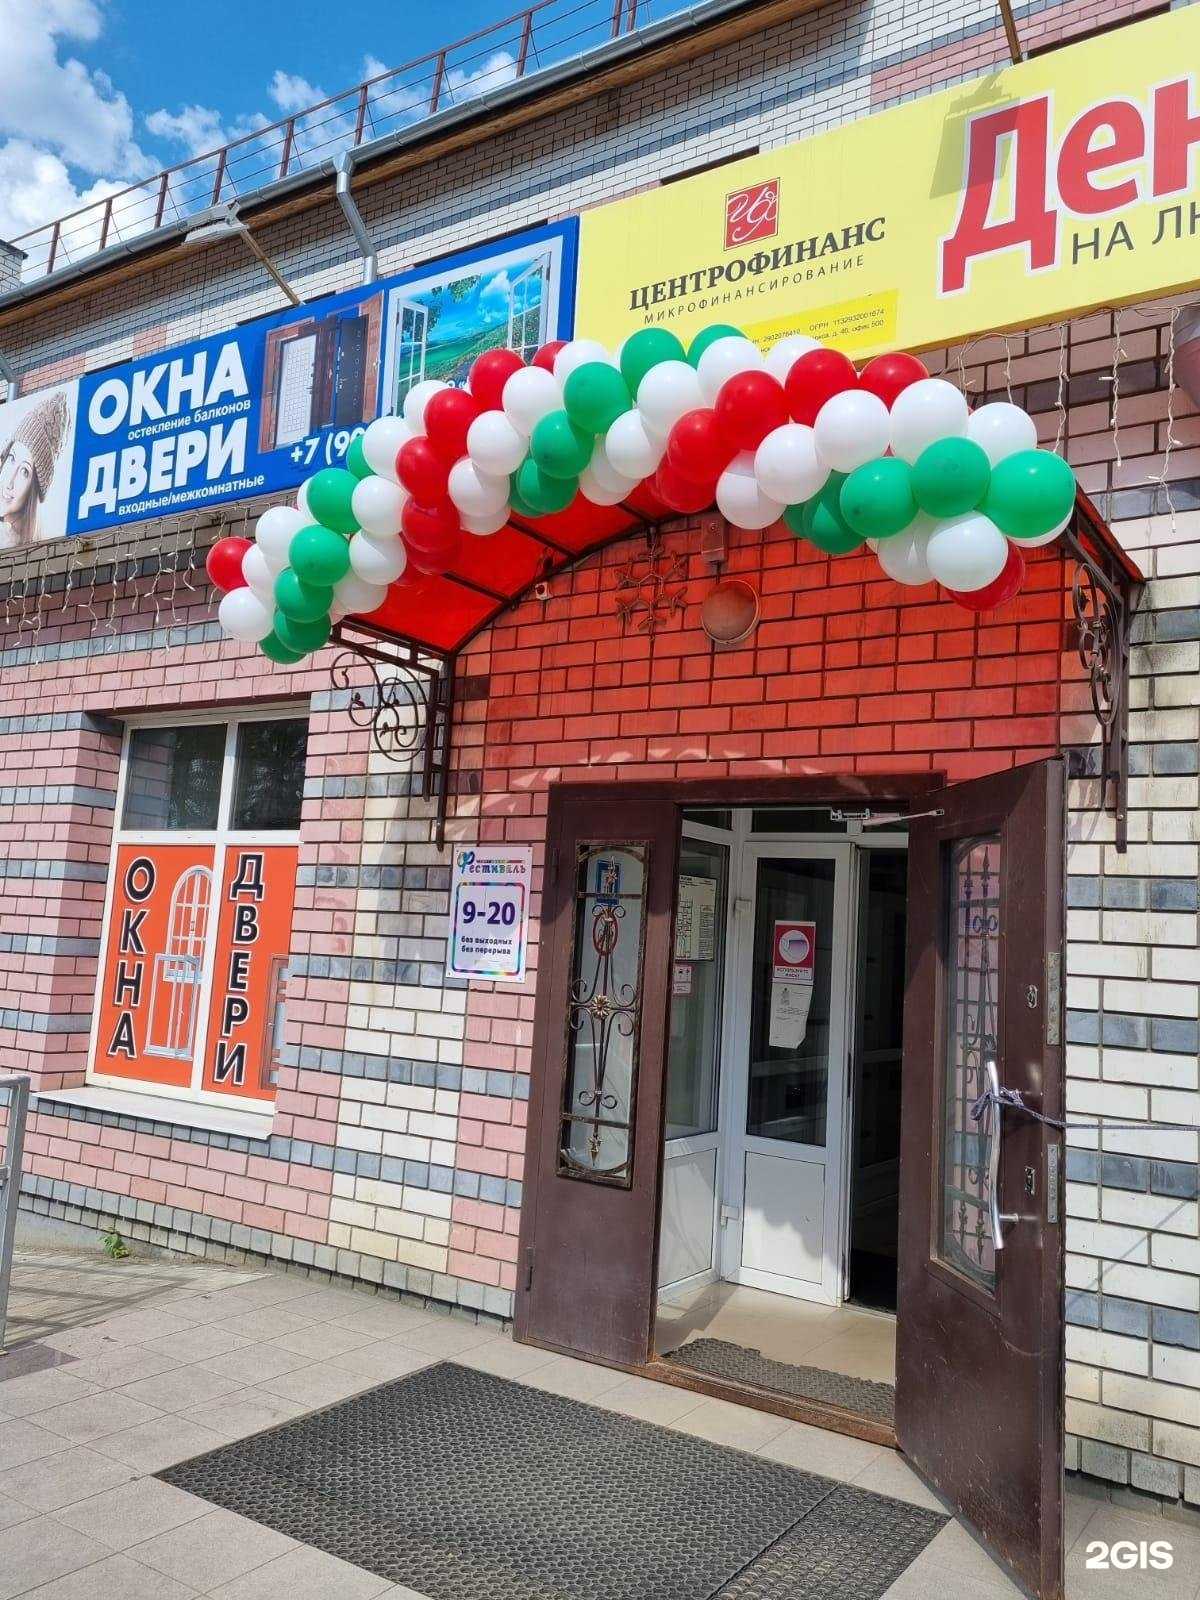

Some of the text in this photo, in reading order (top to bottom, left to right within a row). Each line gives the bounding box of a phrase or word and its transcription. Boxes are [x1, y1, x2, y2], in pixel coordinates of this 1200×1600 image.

[629, 216, 886, 311] ЦЕНТРОФИНАНС
[1072, 220, 1135, 265] НА
[644, 254, 865, 325] МИКРОФИНАНСИРОВАНИЕ
[88, 341, 249, 435] ОКНА
[128, 399, 251, 441] остекление балконов
[77, 417, 248, 520] ДВЕРИ
[290, 437, 320, 465] +7
[118, 474, 265, 516] входные/межкомнатные
[457, 851, 526, 874] Фестиваль
[462, 901, 516, 926] 9-20
[108, 856, 157, 1059] ОКНА
[461, 935, 512, 945] без выходных
[461, 945, 511, 956] без перерыва
[213, 852, 265, 1086] ДВЕРИ
